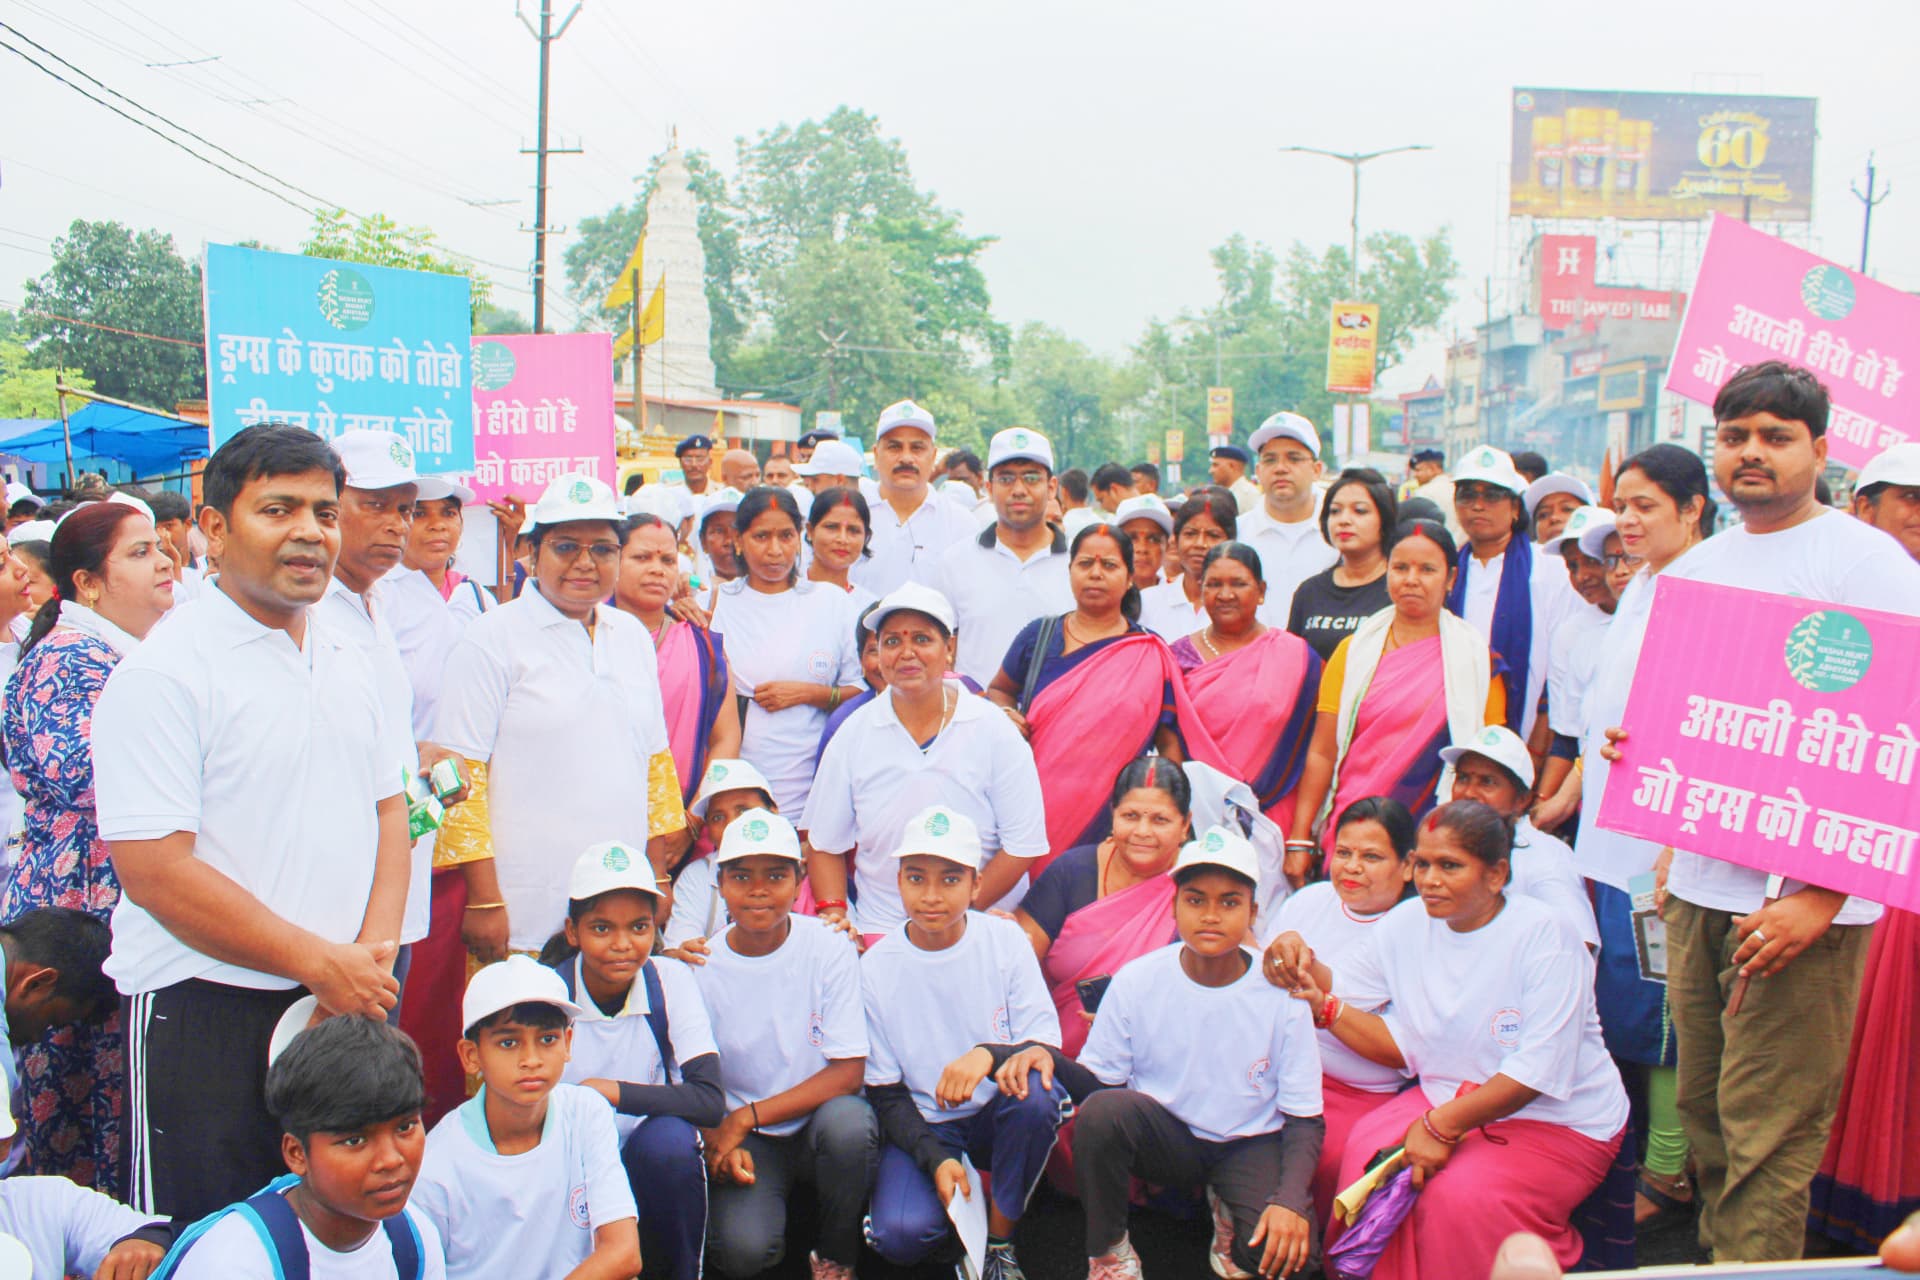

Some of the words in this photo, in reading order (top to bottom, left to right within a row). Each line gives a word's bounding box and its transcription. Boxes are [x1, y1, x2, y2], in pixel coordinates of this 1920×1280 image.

[1697, 125, 1770, 169] 60
[218, 333, 272, 385] ड्रग्स
[276, 327, 303, 377] के
[308, 340, 374, 394] कुचक्र
[378, 337, 411, 385] को
[415, 340, 463, 400] तोड़ो
[1693, 344, 1729, 387] जो
[1727, 303, 1807, 359] असली
[1805, 330, 1854, 379] हीरो
[1853, 347, 1883, 391] वो
[1880, 356, 1904, 398] है
[400, 406, 454, 466] जोड़ो
[486, 400, 530, 436] हीरो
[533, 398, 558, 434] वो
[557, 397, 579, 433] है
[1827, 402, 1879, 449] हता
[475, 450, 506, 487] को
[1680, 694, 1796, 758] असली
[1796, 707, 1873, 775] हीरो
[1875, 722, 1920, 786] वो
[1632, 758, 1684, 815] जो
[1679, 776, 1757, 836] ड्रग्स
[1757, 786, 1812, 848] को
[1812, 808, 1919, 876] कहता
